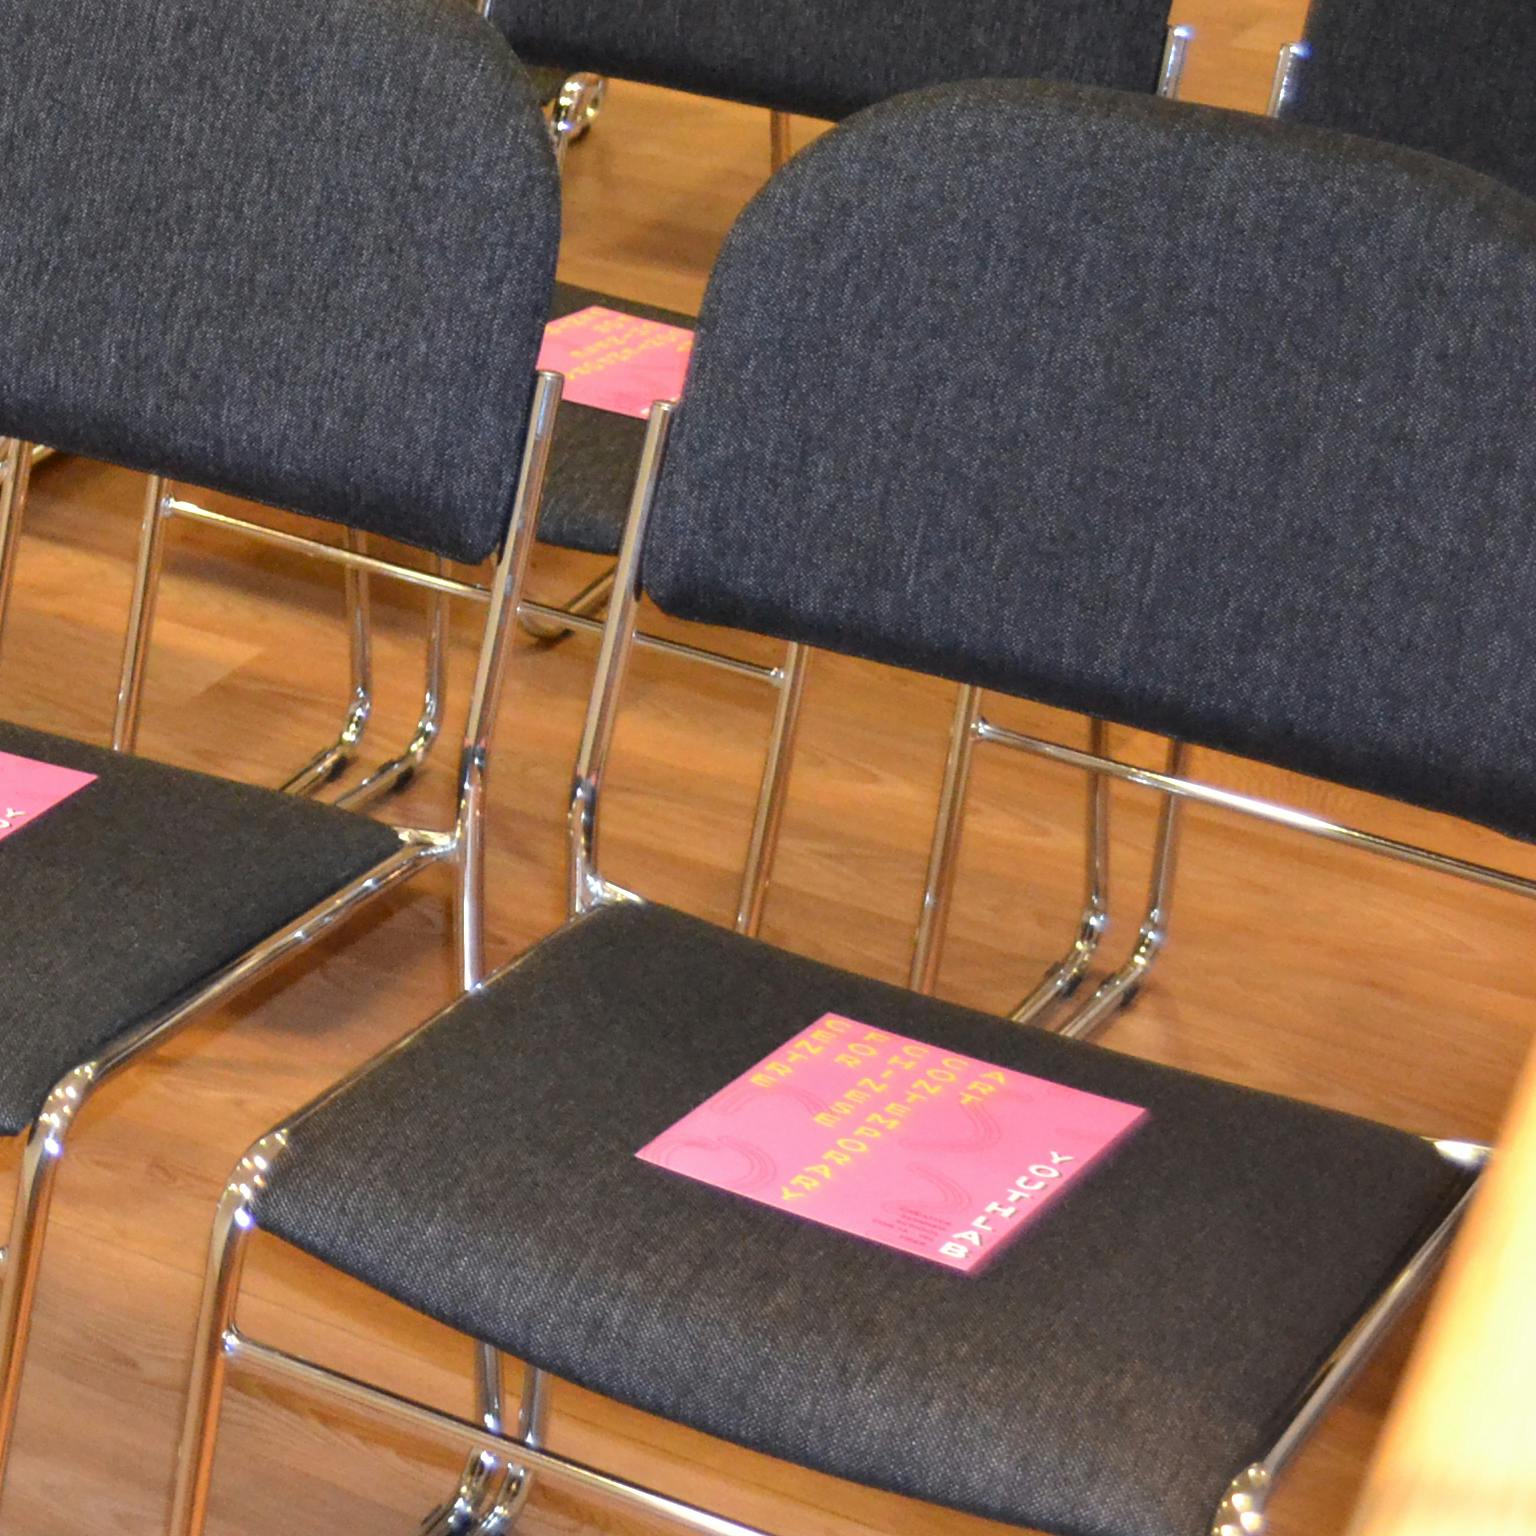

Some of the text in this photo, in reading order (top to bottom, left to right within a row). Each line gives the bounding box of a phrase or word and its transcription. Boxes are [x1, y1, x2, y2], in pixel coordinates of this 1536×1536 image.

[749, 1017, 852, 1088] CENTRE
[812, 1044, 929, 1127] CHINESE
[834, 1031, 890, 1068] FOR
[959, 1070, 1008, 1105] ART
[780, 1057, 969, 1201] CONTEMPORARY
[938, 1151, 1074, 1259] YOUTHLAB
